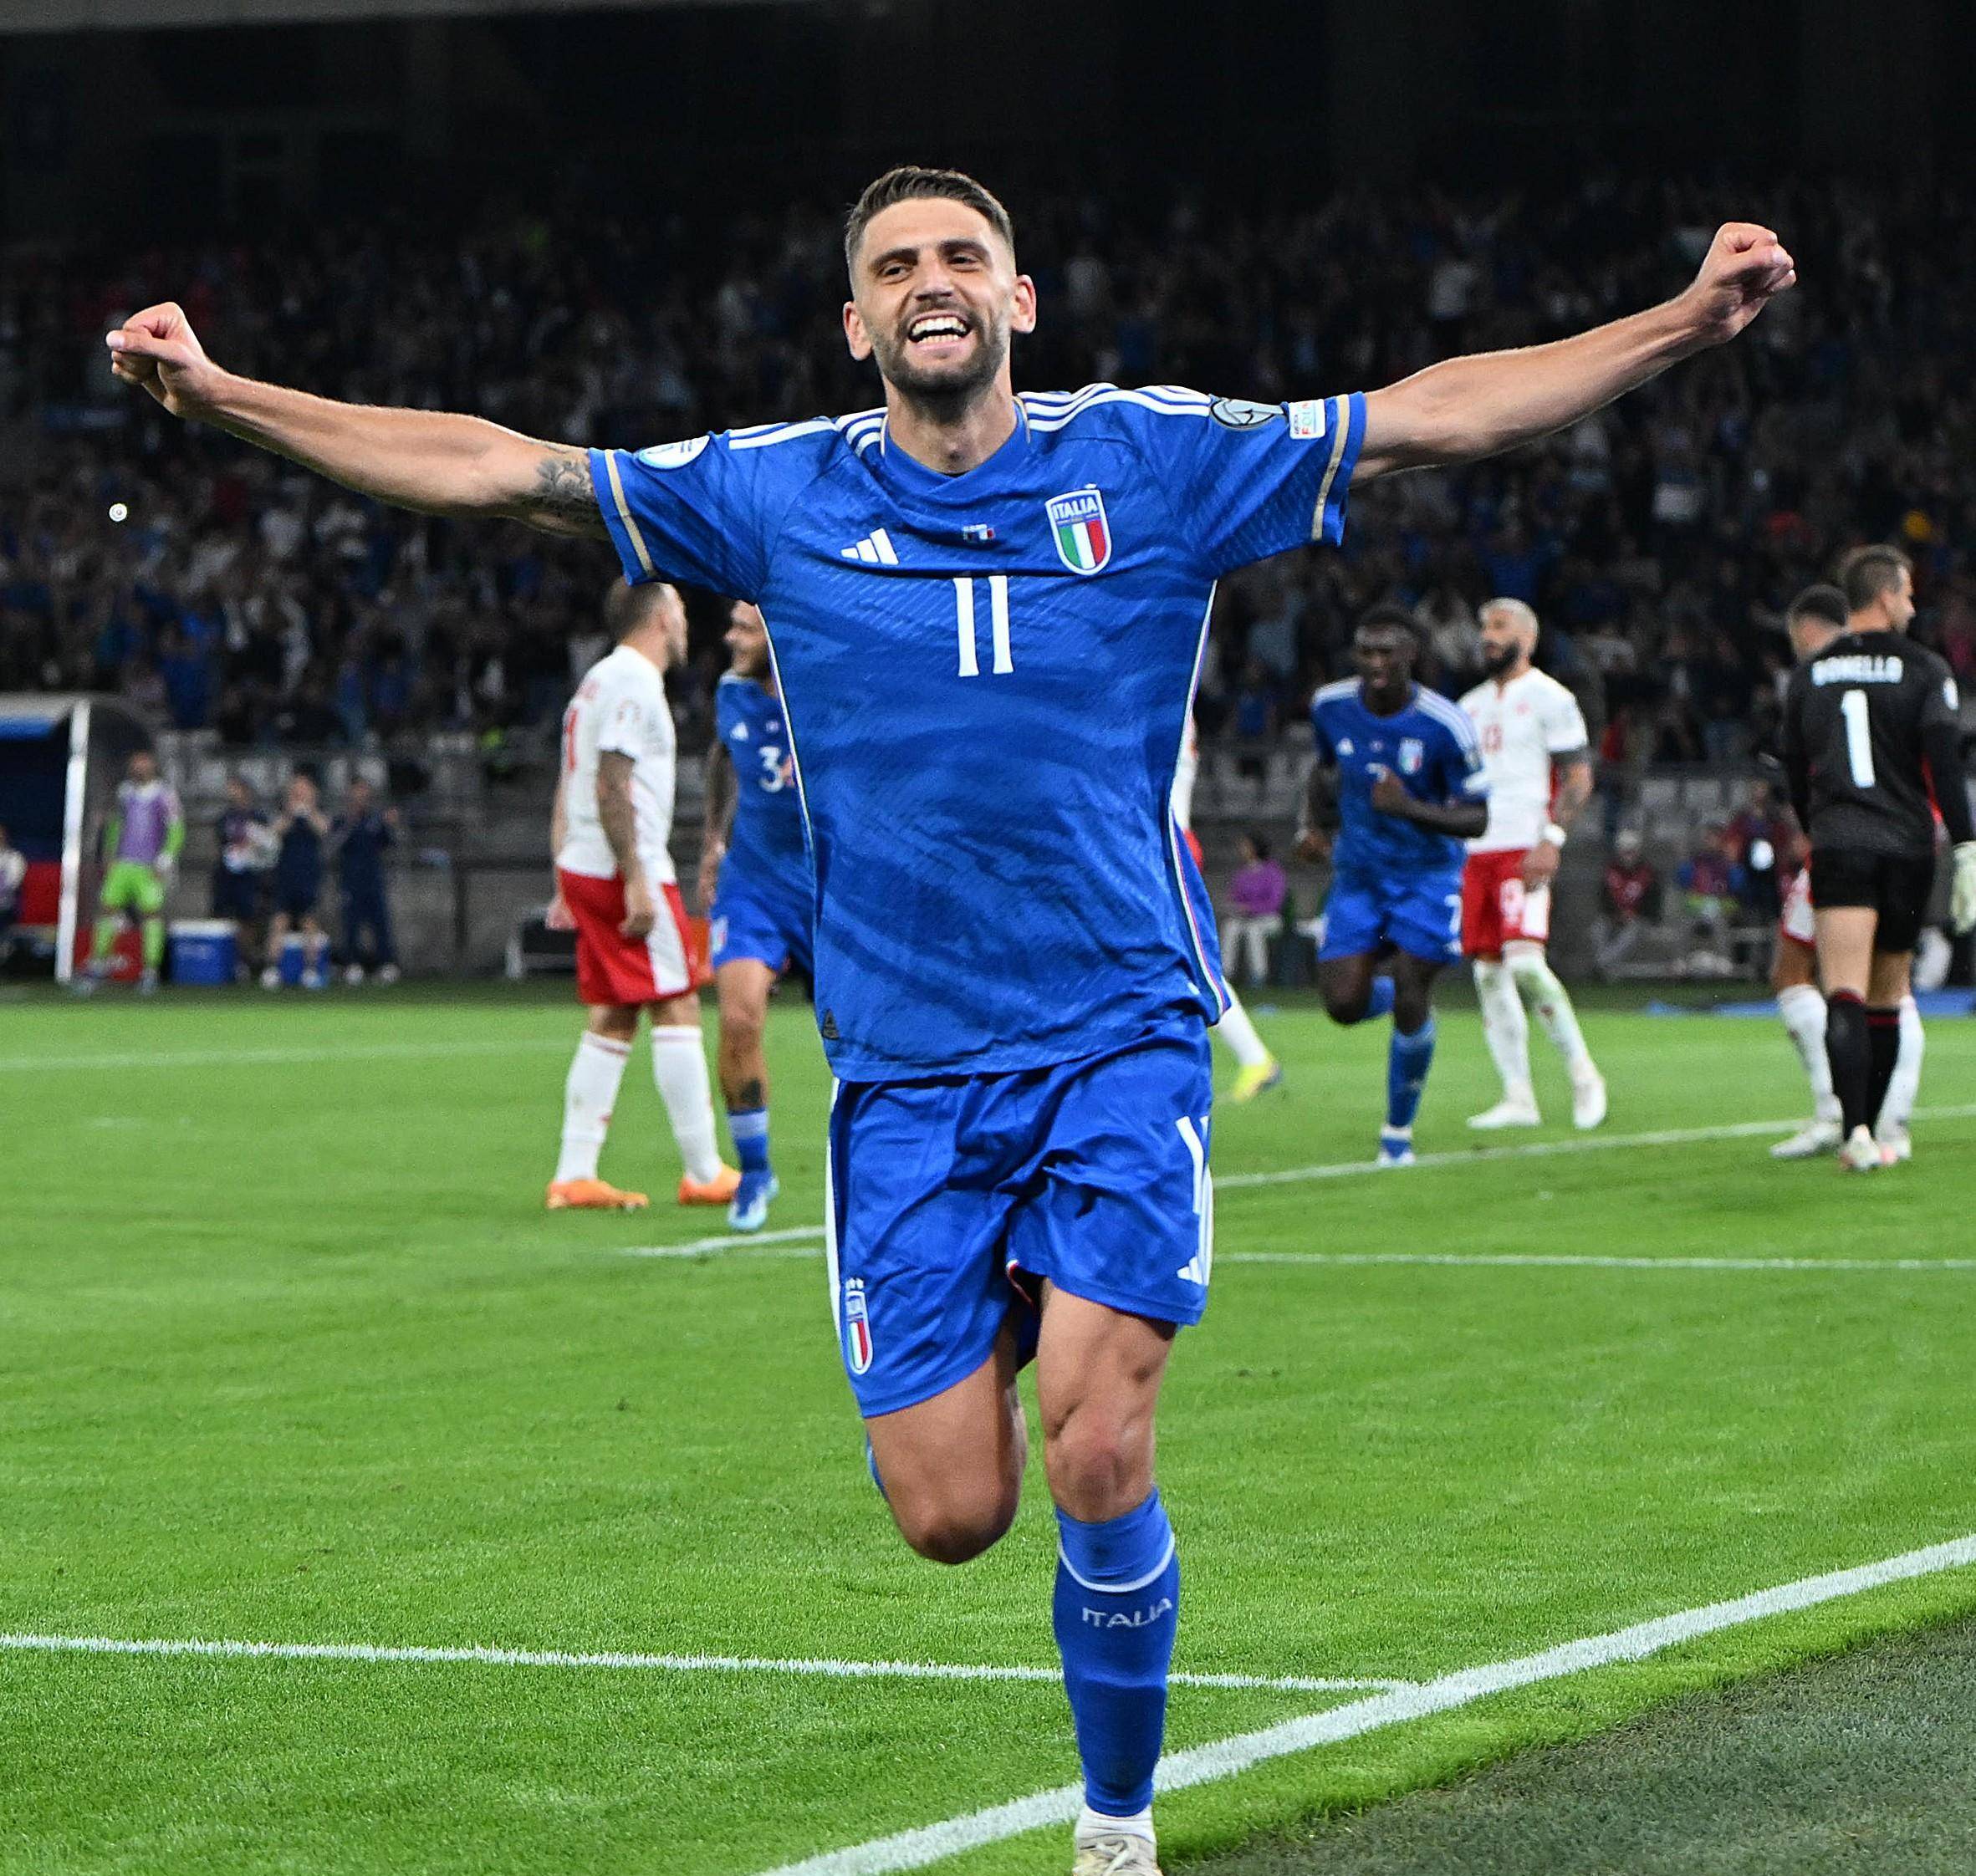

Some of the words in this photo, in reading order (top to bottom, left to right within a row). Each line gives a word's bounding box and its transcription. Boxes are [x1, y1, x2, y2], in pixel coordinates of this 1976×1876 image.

[1051, 496, 1098, 519] ITALIA
[952, 574, 1014, 676] 11
[1841, 689, 1876, 788] 1
[758, 747, 784, 793] 3
[1082, 1598, 1172, 1629] ITALIA
